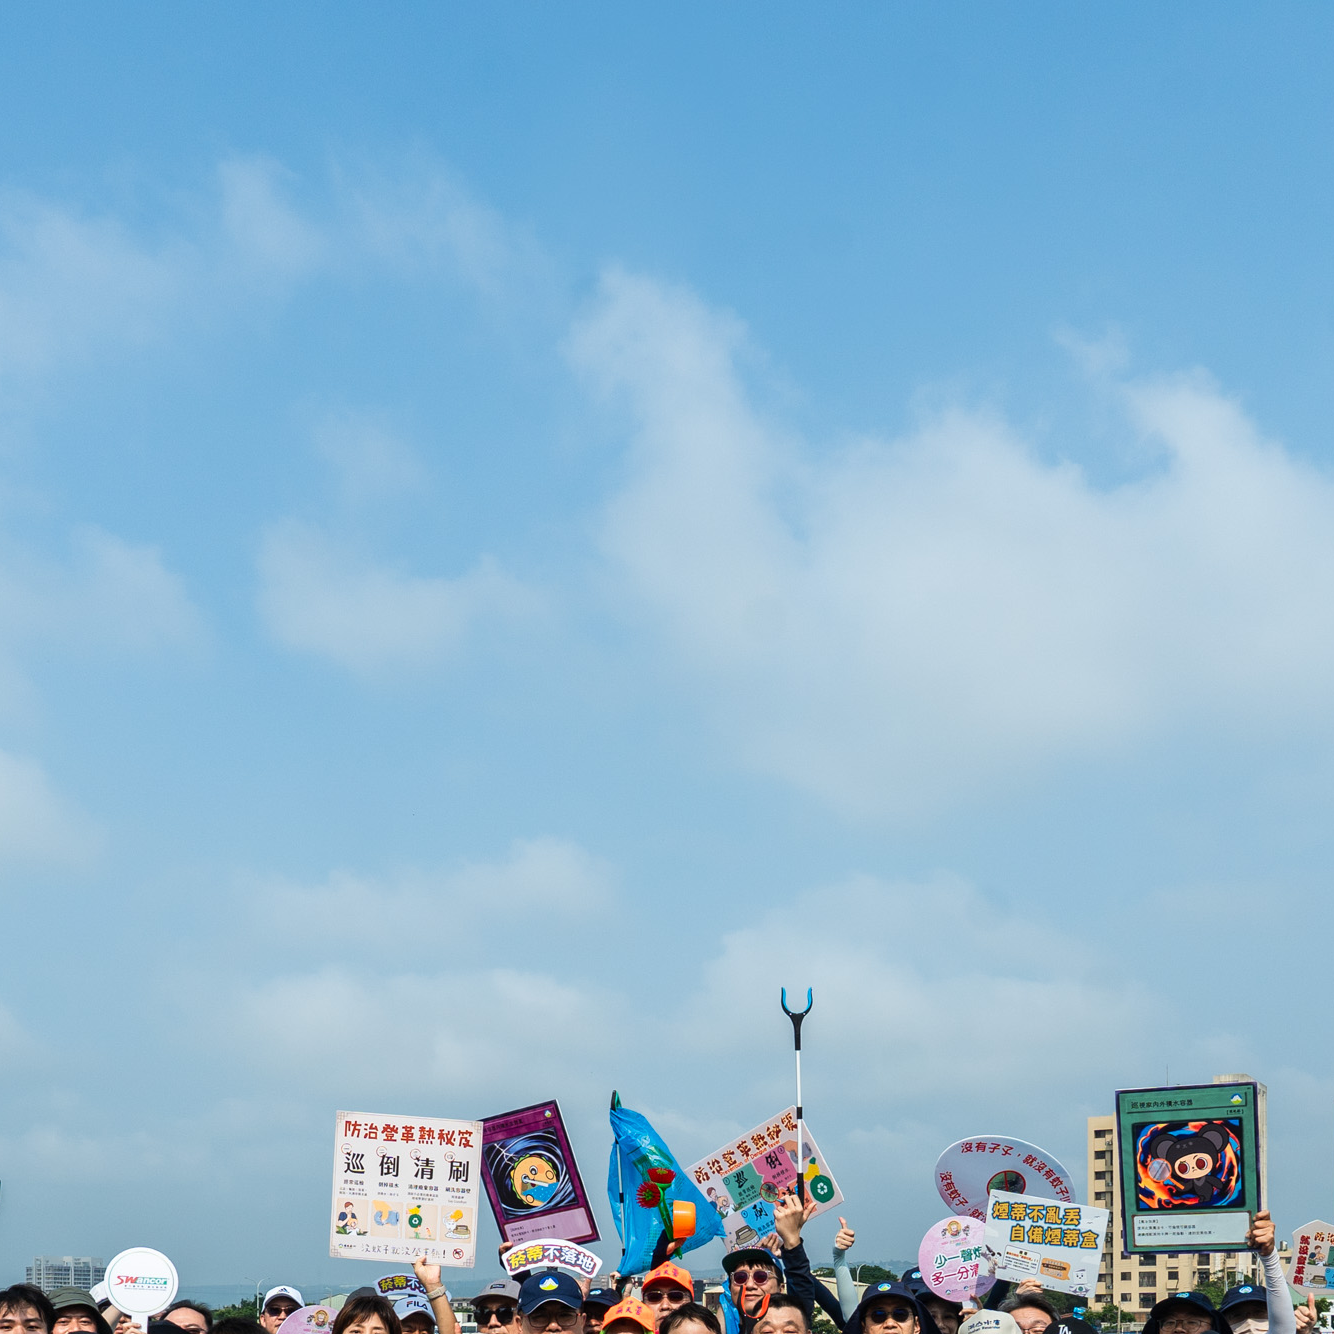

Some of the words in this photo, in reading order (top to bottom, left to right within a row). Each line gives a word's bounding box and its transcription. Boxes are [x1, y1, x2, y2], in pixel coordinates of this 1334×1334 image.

[344, 1120, 474, 1149] 防治登革熱秘笈
[344, 1152, 365, 1174] 巡
[378, 1154, 400, 1177] 倒
[413, 1157, 435, 1180] 清
[447, 1160, 469, 1183] 刷
[992, 1201, 1081, 1226] 煙蒂不亂丟
[1010, 1225, 1099, 1249] 自備煙蒂盒
[509, 1243, 597, 1277] 菸蒂不落地
[379, 1275, 427, 1294] 菸蒂不
[406, 1300, 429, 1310] FILA
